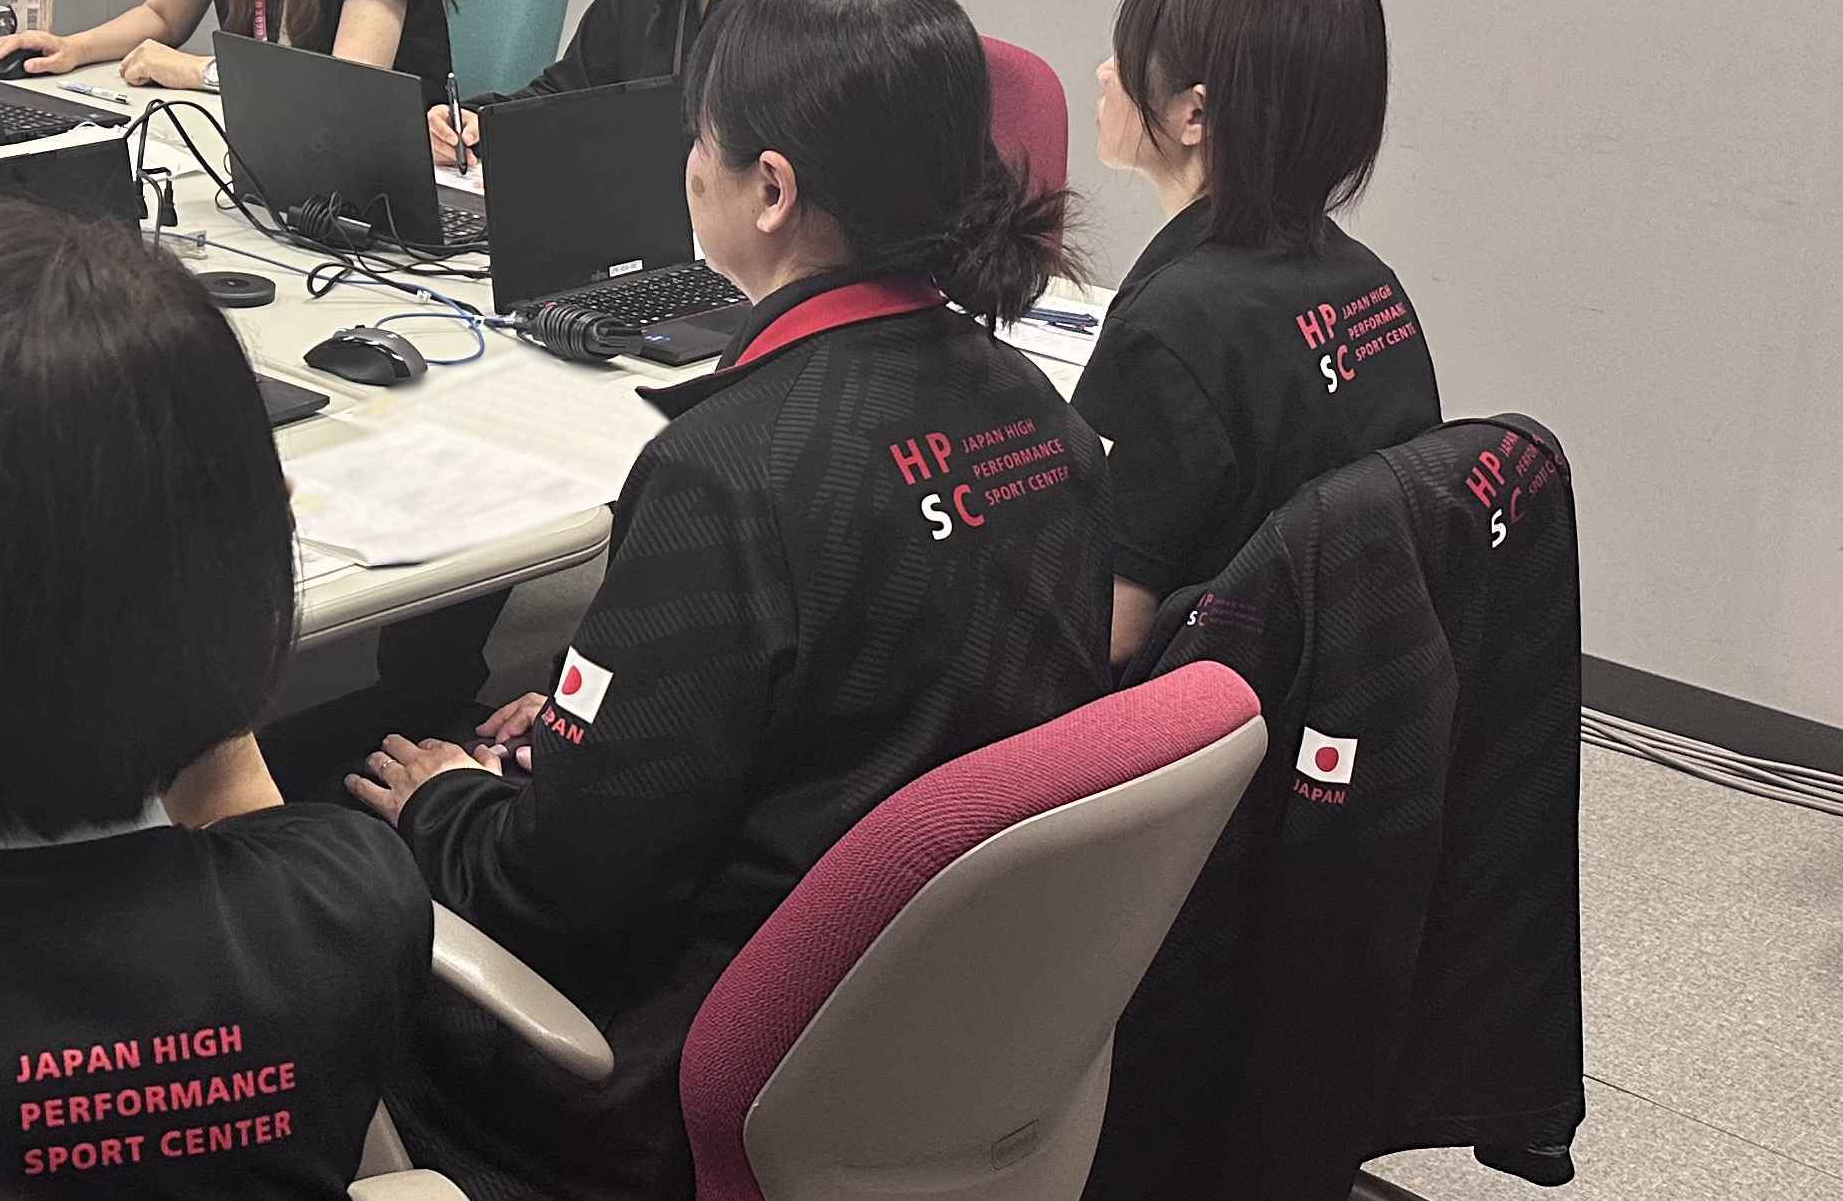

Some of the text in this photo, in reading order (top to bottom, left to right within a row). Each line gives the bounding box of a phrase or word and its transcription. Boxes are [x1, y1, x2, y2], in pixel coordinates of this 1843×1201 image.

[1341, 283, 1393, 320] JAPAN HIGH
[1347, 301, 1407, 341] PERFORMAN
[1295, 303, 1337, 349] HP
[1320, 344, 1355, 393] SC
[1355, 336, 1386, 362] SPORT
[961, 418, 1037, 454] JAPAN HIGH
[972, 437, 1065, 479] PERFORMANCE
[889, 432, 951, 485] HP
[1465, 450, 1506, 509] HP
[920, 484, 986, 541] SC
[985, 480, 1026, 506] SPORT
[541, 705, 585, 744] PAN
[1293, 778, 1346, 804] JAPAN
[16, 1024, 243, 1084] JAPAN HIGH
[20, 1062, 296, 1132] PERFORMANCE
[24, 1109, 293, 1176] SPORT CENTER
